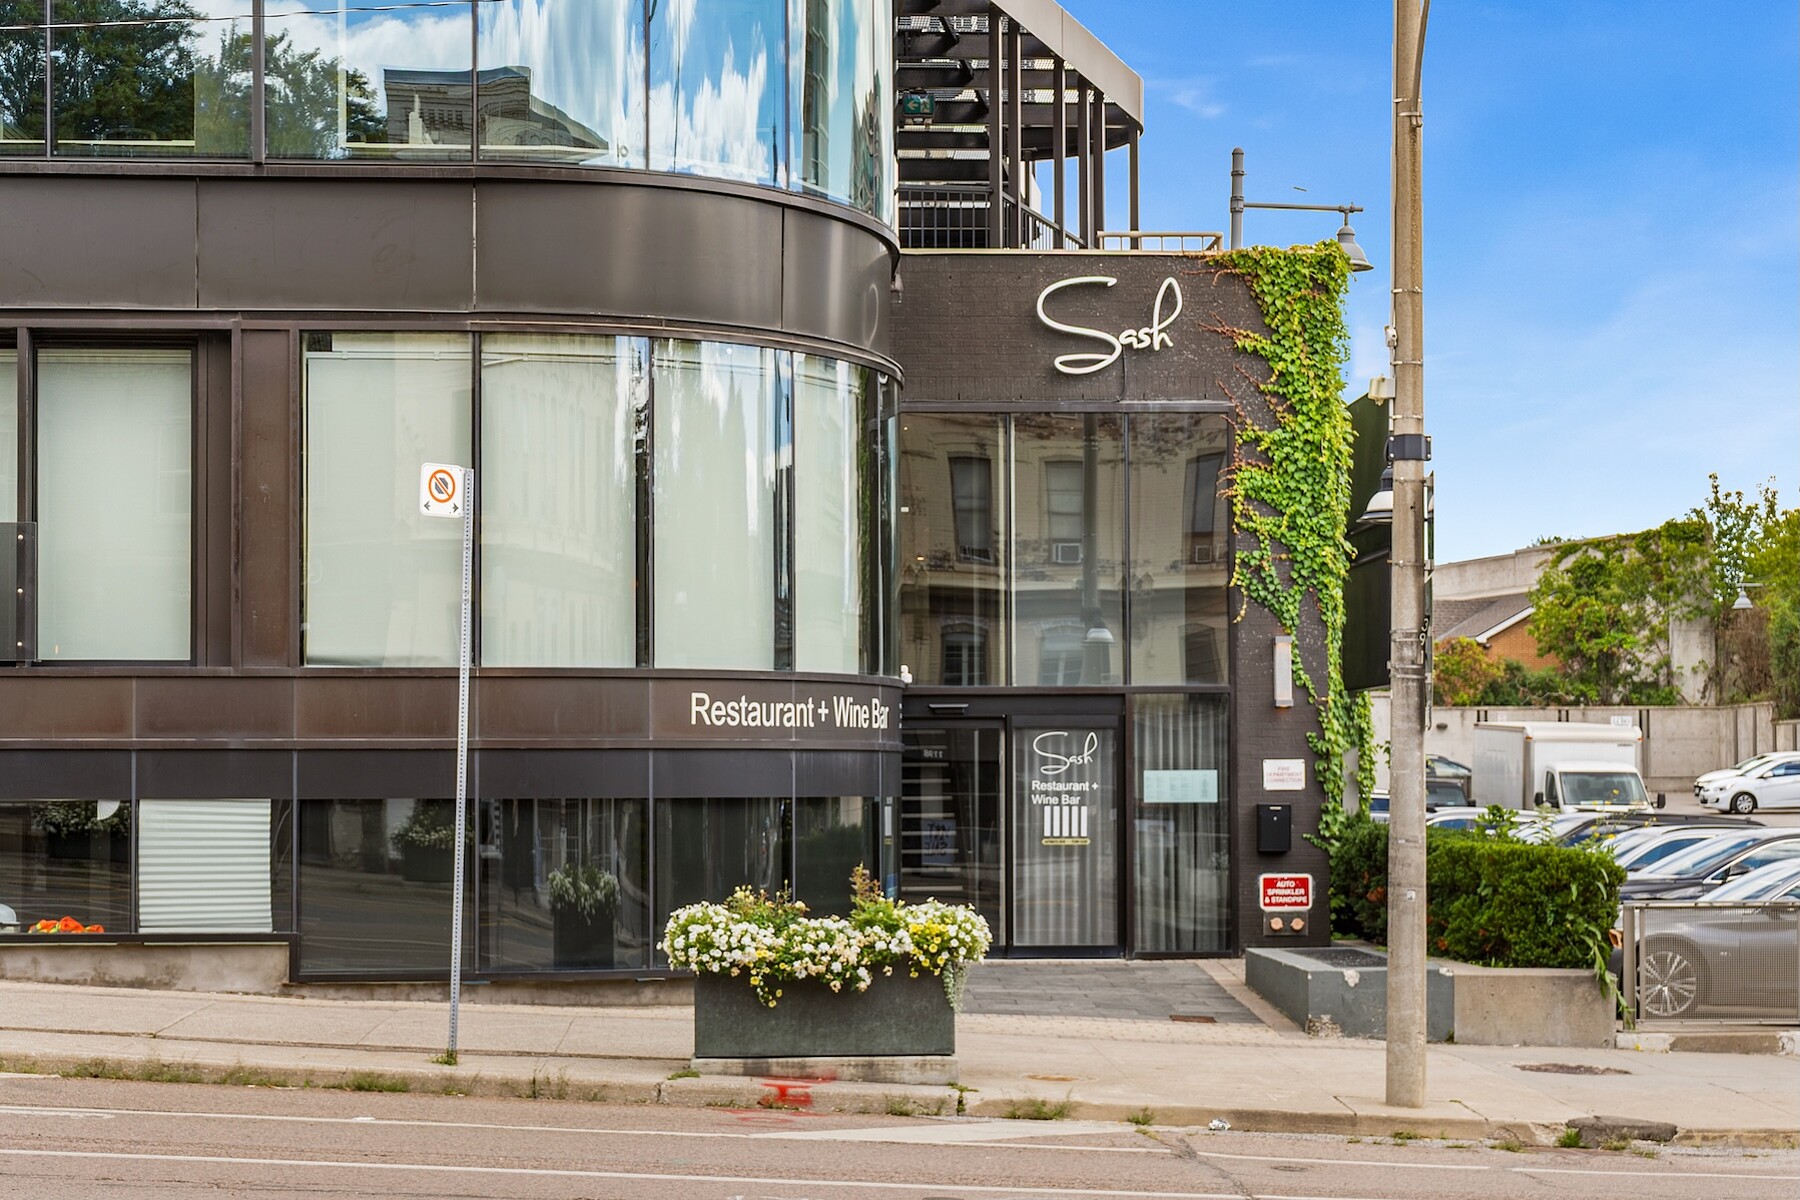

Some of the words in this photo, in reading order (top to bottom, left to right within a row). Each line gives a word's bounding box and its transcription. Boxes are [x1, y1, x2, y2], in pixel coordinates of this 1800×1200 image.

[1037, 276, 1183, 374] Sash
[690, 692, 815, 728] Restaurant
[817, 700, 829, 722] +
[833, 696, 869, 728] Wine
[871, 698, 889, 729] Bar
[1033, 731, 1098, 775] Sash
[1031, 780, 1089, 791] Restaurant
[1091, 782, 1099, 790] +
[1031, 794, 1059, 805] Wine
[1061, 794, 1081, 805] Bar
[1276, 880, 1295, 888] AUTO
[1266, 888, 1305, 896] SPRINKLER
[1270, 896, 1308, 904] STANDPIPE
